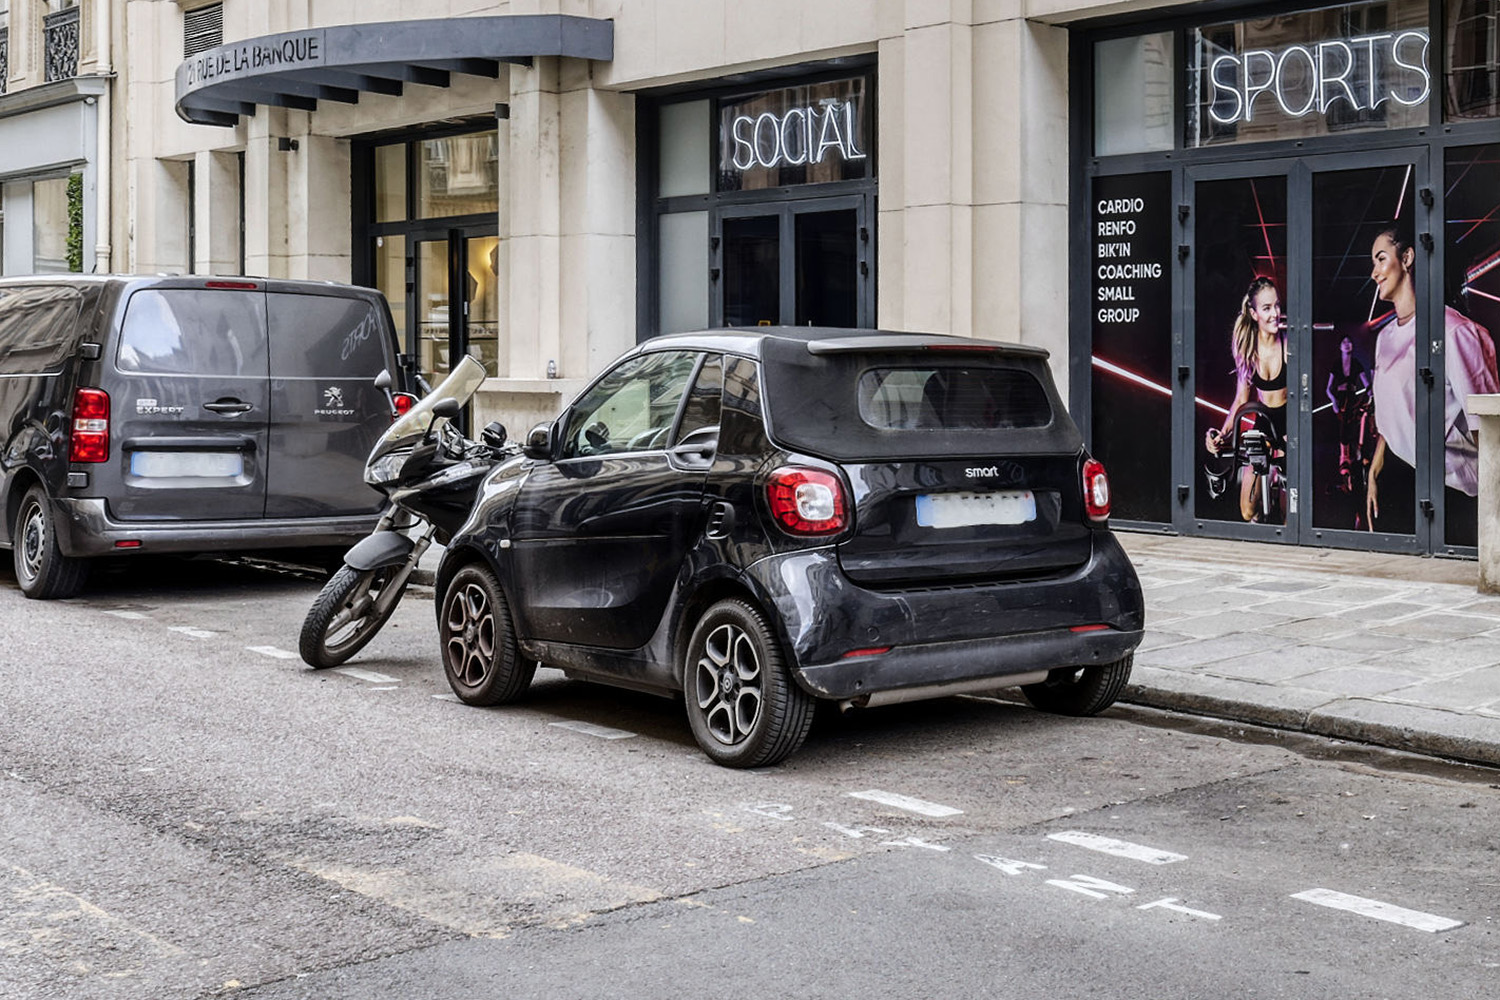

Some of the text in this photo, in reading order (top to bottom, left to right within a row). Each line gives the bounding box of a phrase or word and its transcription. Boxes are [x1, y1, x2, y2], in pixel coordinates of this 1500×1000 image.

[197, 58, 214, 82] RUE
[216, 54, 231, 75] DE
[234, 47, 249, 71] LA
[252, 37, 319, 68] BANQUE
[1209, 31, 1431, 123] SPORTS
[732, 100, 867, 170] SOCIAL
[1098, 198, 1144, 214] CARDIO
[1098, 220, 1136, 236] RENFO
[1098, 242, 1131, 258] BIK'IN
[1098, 263, 1162, 280] COACHING
[1098, 286, 1135, 301] SMALL
[1098, 308, 1140, 323] GROUP
[136, 406, 184, 415] EXPERT
[965, 465, 1000, 479] smart
